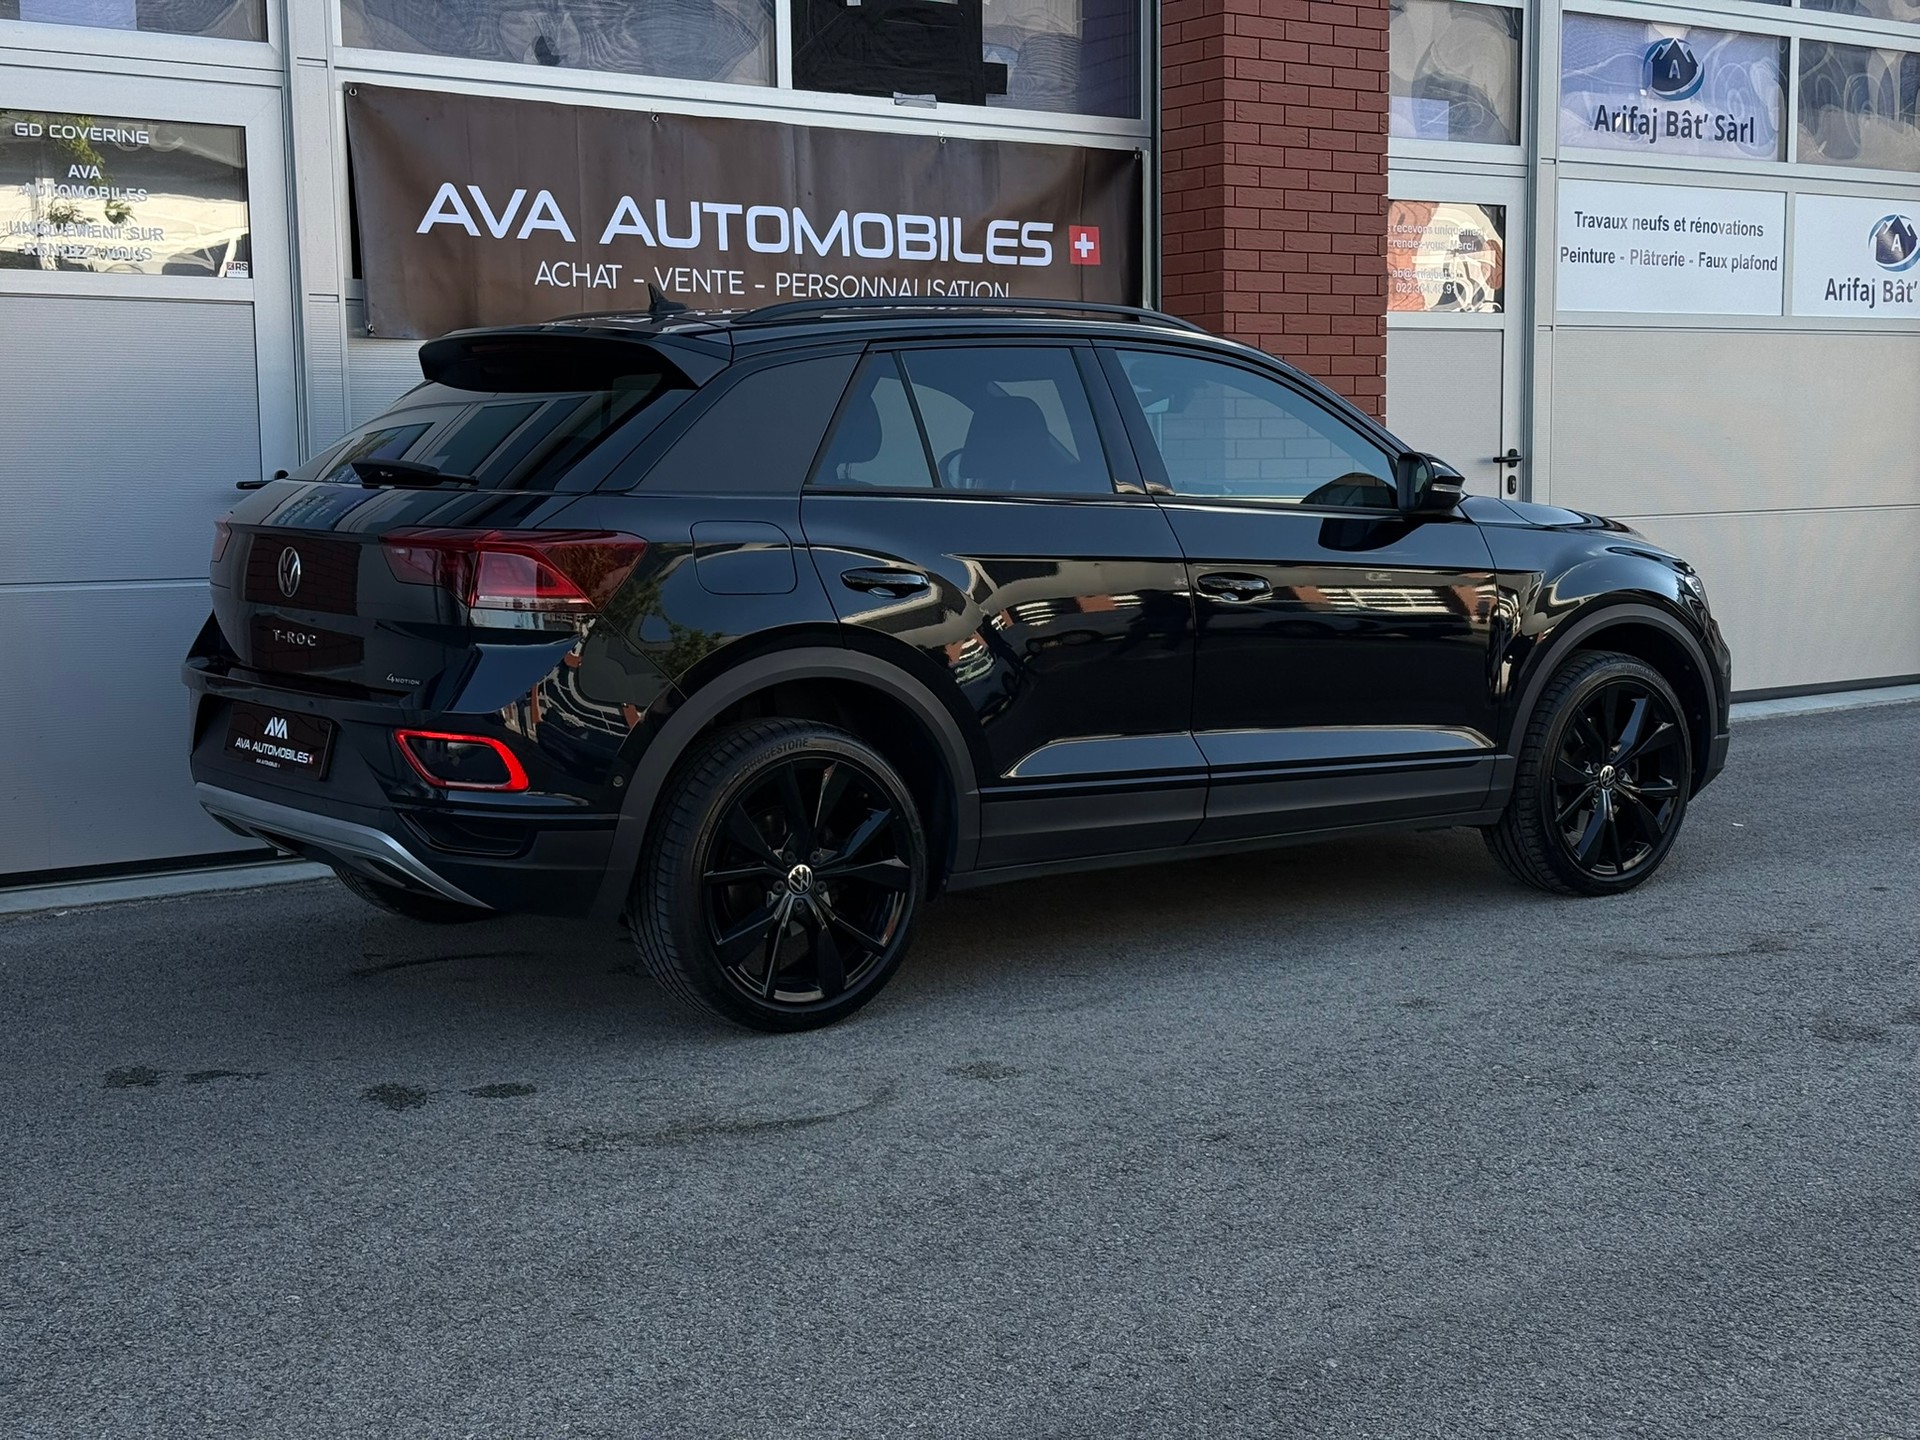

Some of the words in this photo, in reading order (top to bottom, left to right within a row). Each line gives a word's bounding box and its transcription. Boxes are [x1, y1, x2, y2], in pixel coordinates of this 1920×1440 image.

[14, 122, 43, 137] GD
[49, 125, 149, 144] COVERING
[1593, 104, 1658, 144] Arifaj
[1714, 115, 1754, 143] Sàrl
[68, 164, 101, 179] AVA
[22, 182, 148, 201] AUTOMOBILES
[128, 226, 164, 241] SUR
[416, 182, 576, 242] AVA
[599, 195, 1054, 267] AUTOMOBILES
[1392, 225, 1433, 235] recevons
[1574, 211, 1628, 231] Travaux
[1632, 214, 1670, 232] neufs
[1673, 218, 1687, 233] et
[1690, 218, 1764, 237] rénovations
[1560, 246, 1616, 265] Peinture
[1629, 248, 1685, 268] Plâtrerie
[1699, 252, 1728, 270] Faux
[1731, 254, 1778, 273] plafond
[534, 260, 622, 289] ACHAT
[654, 266, 745, 295] VENTE
[776, 272, 1009, 299] PERSONNALISATION
[1825, 277, 1875, 309] Arifaj
[272, 629, 317, 647] T-ROC
[386, 672, 421, 686] 4MOTION
[235, 737, 251, 751] AVA
[251, 741, 309, 764] AUTOMOBILES
